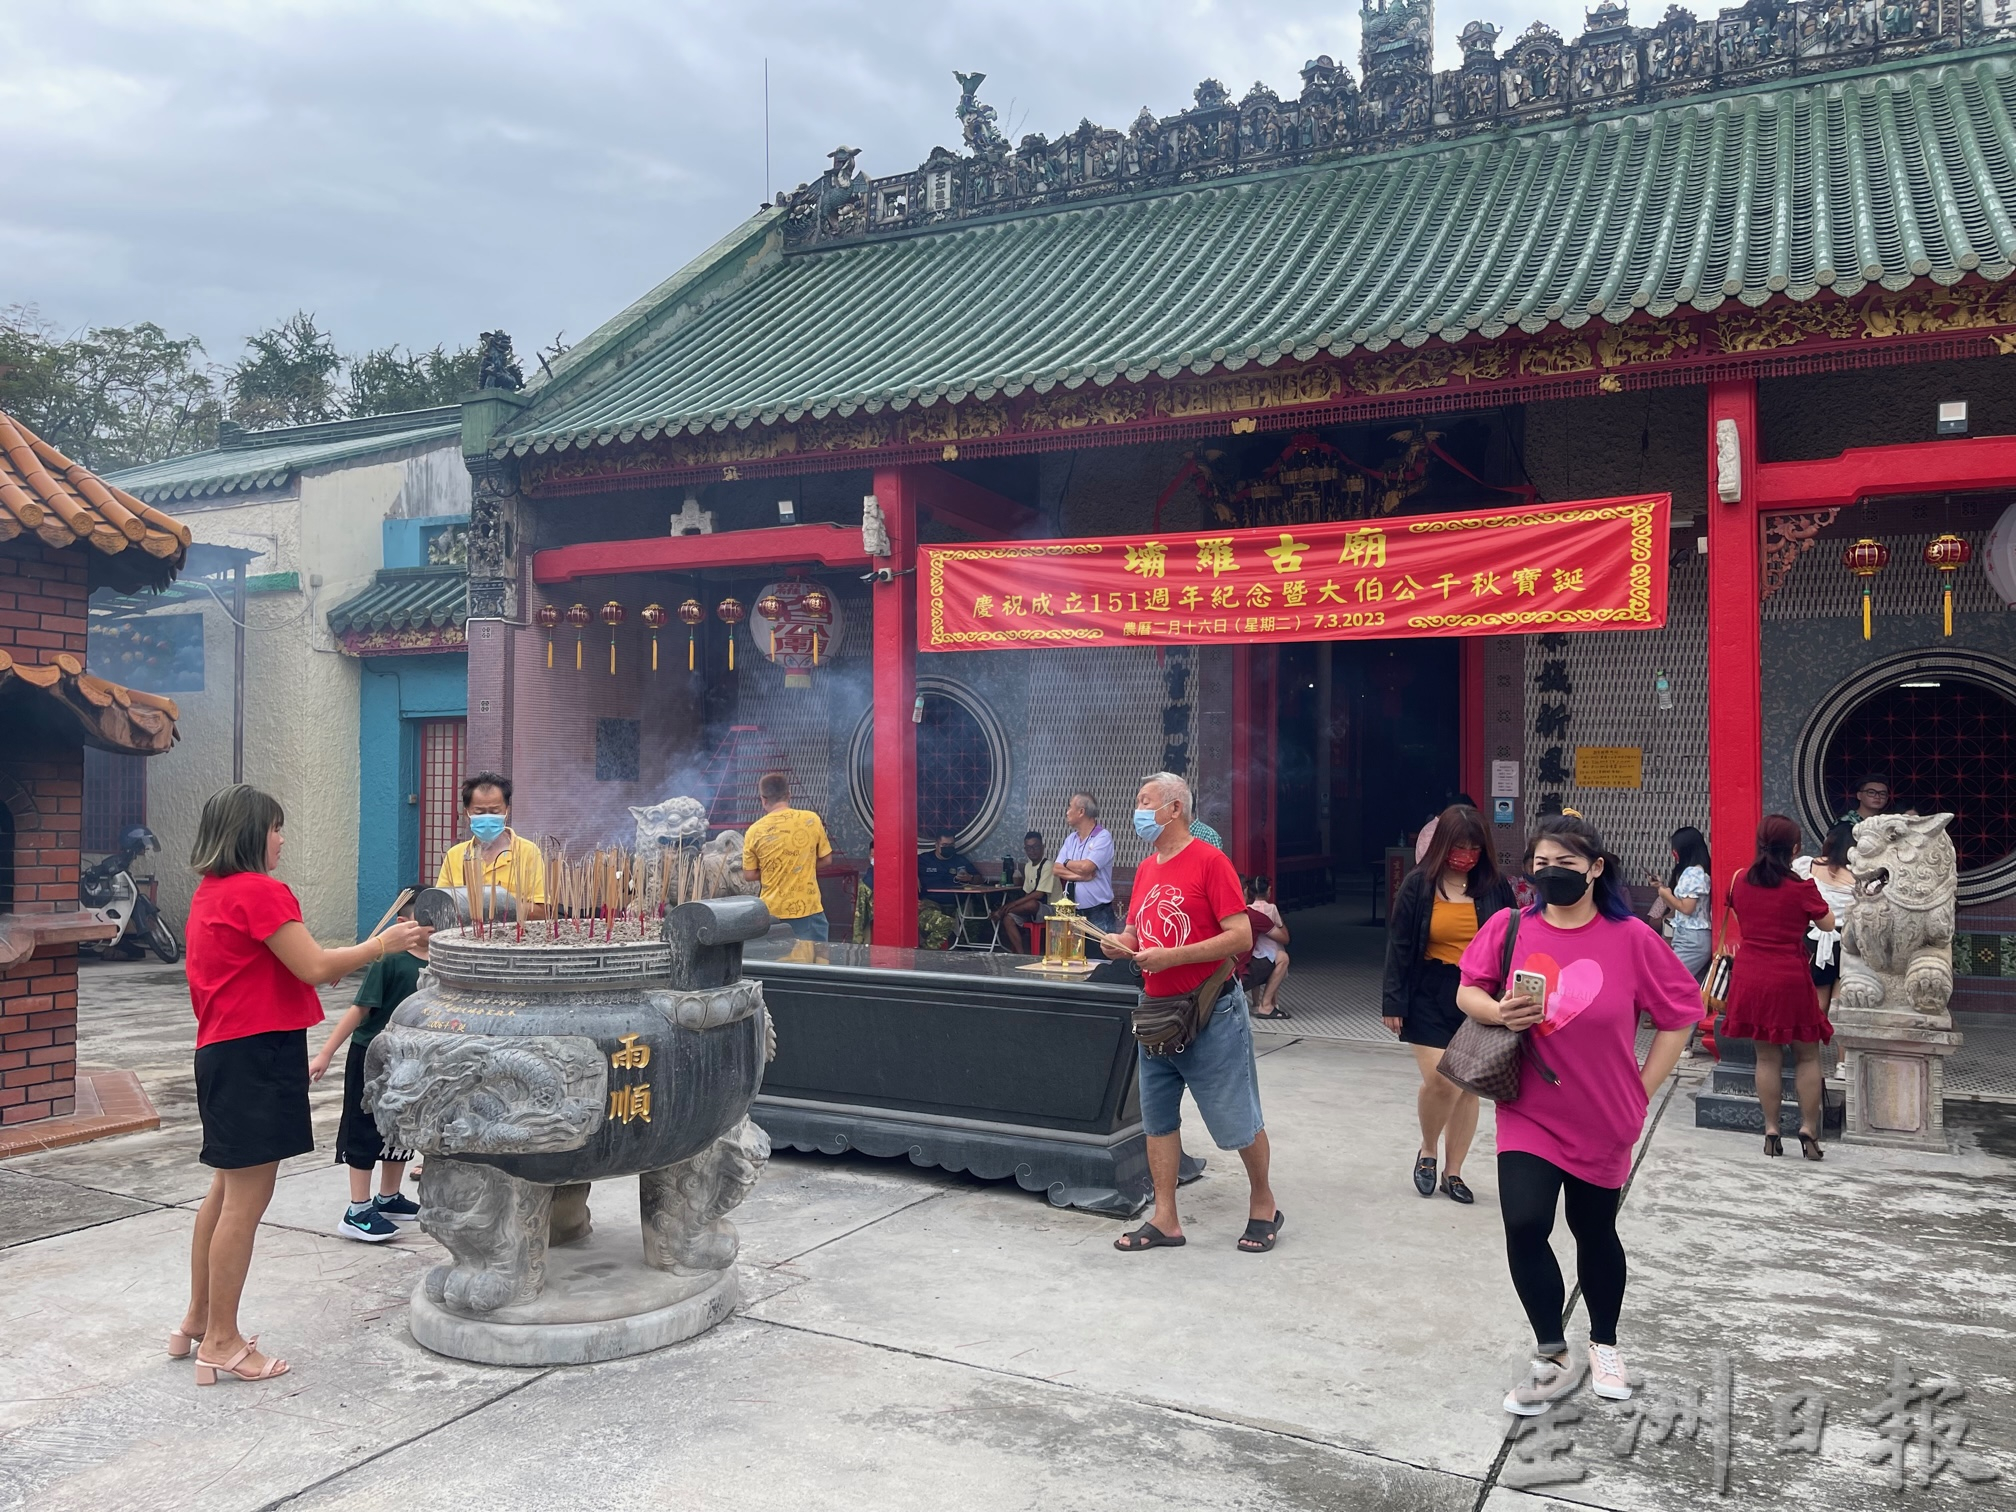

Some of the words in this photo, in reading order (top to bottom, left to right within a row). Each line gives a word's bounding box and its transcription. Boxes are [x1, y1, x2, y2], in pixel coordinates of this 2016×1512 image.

[1123, 527, 1387, 579] 壩羅古廟
[972, 567, 1587, 619] 慶祝成立151週年紀念暨大伯公千秋寶誕
[1314, 612, 1385, 629] 7.3.2023
[608, 1032, 652, 1124] 雨順
